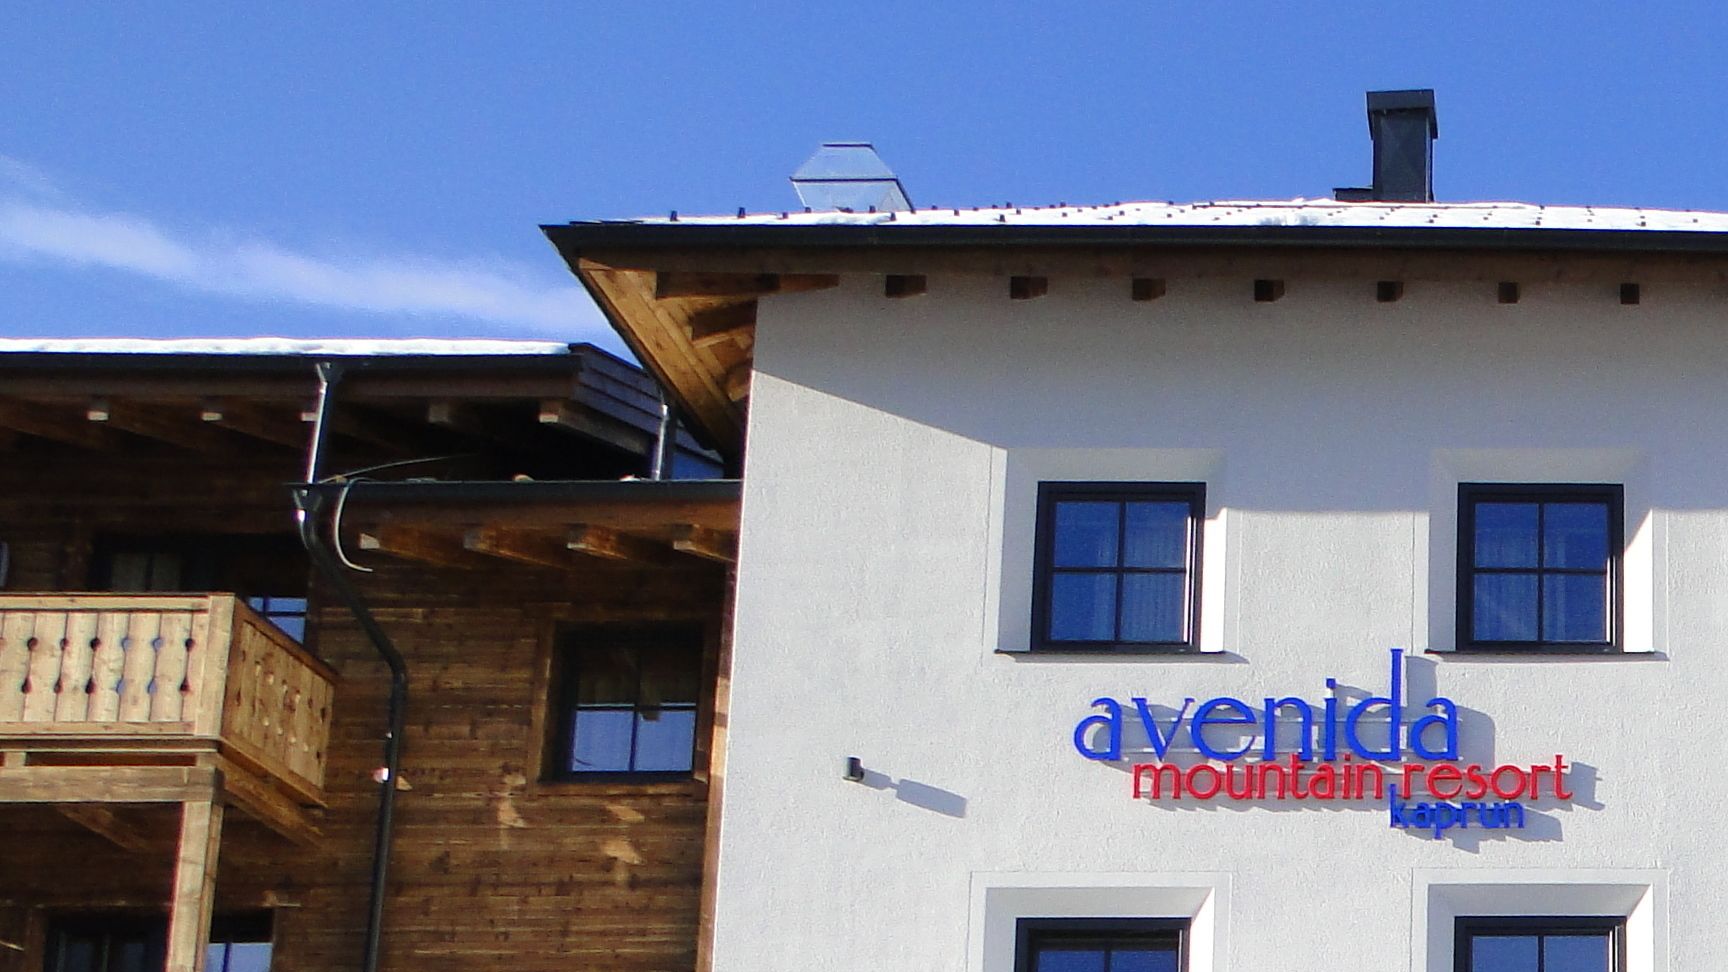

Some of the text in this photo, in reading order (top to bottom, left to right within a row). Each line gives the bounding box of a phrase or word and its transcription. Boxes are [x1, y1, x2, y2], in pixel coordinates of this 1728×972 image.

[1073, 648, 1458, 762] avenida
[1132, 753, 1573, 799] mountain resort
[1389, 784, 1525, 839] kaprun
